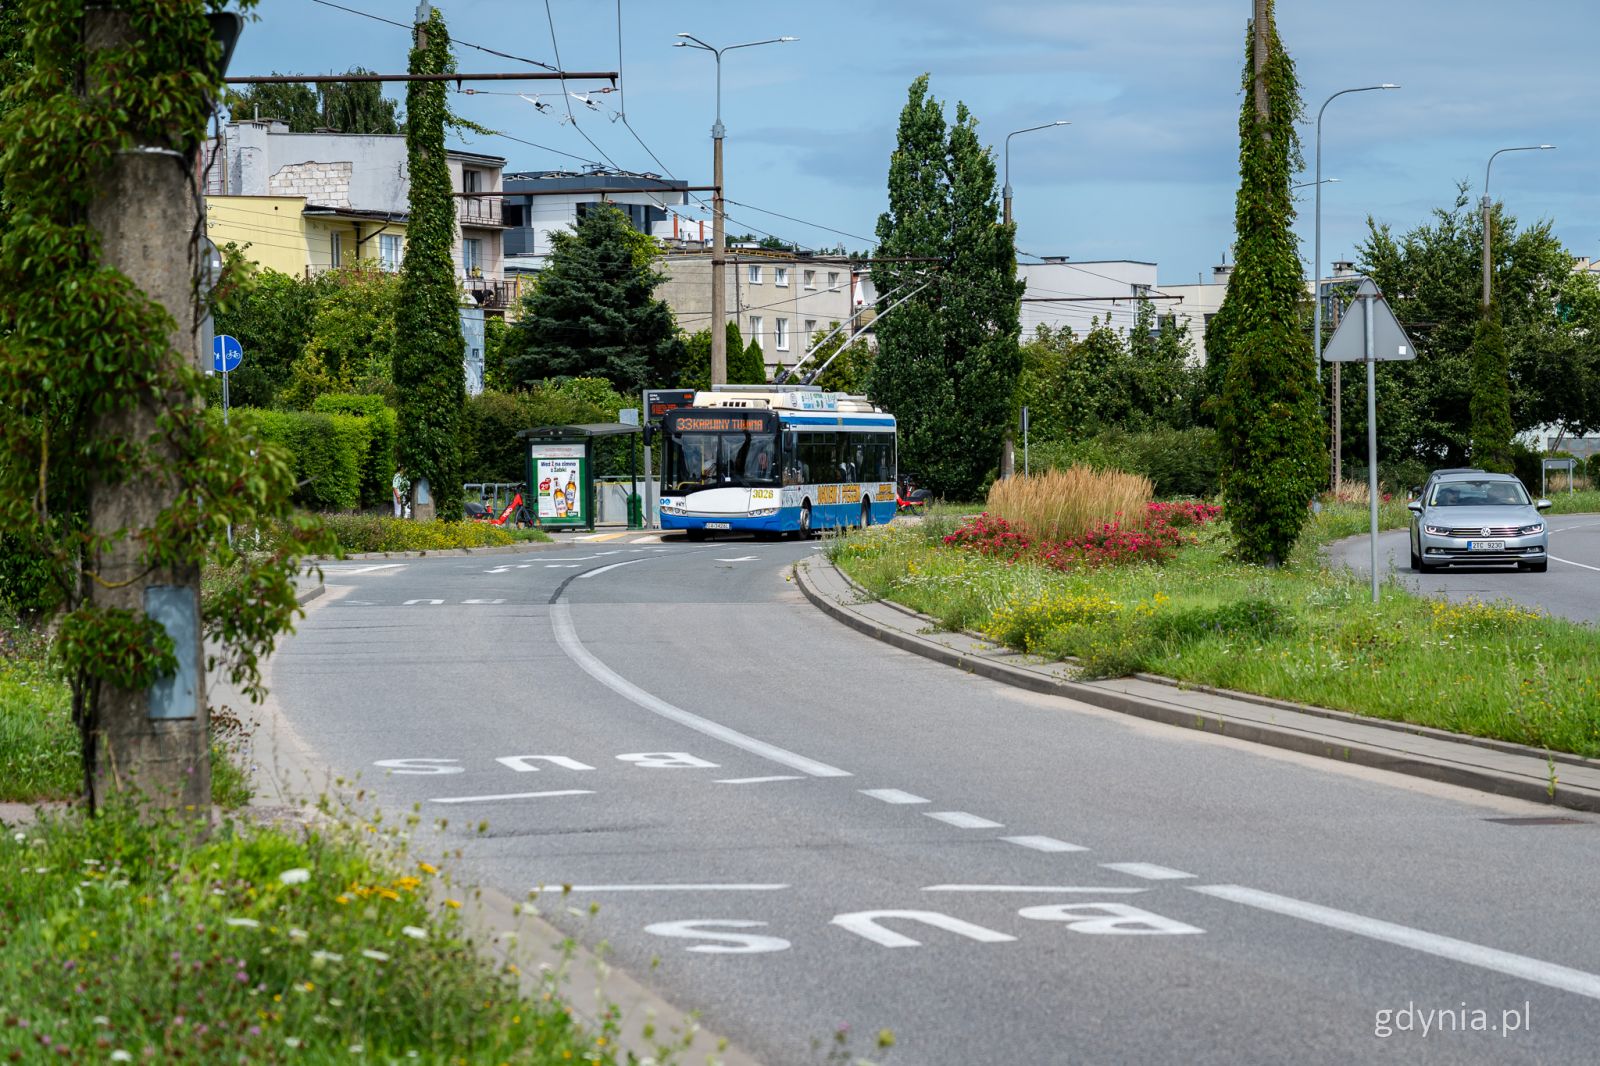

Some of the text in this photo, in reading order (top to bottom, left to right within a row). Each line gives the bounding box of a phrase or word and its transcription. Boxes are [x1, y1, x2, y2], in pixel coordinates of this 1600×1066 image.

[676, 418, 692, 431] 33
[752, 489, 774, 499] 3026
[372, 750, 721, 776] BUS
[643, 900, 1206, 955] BUS
